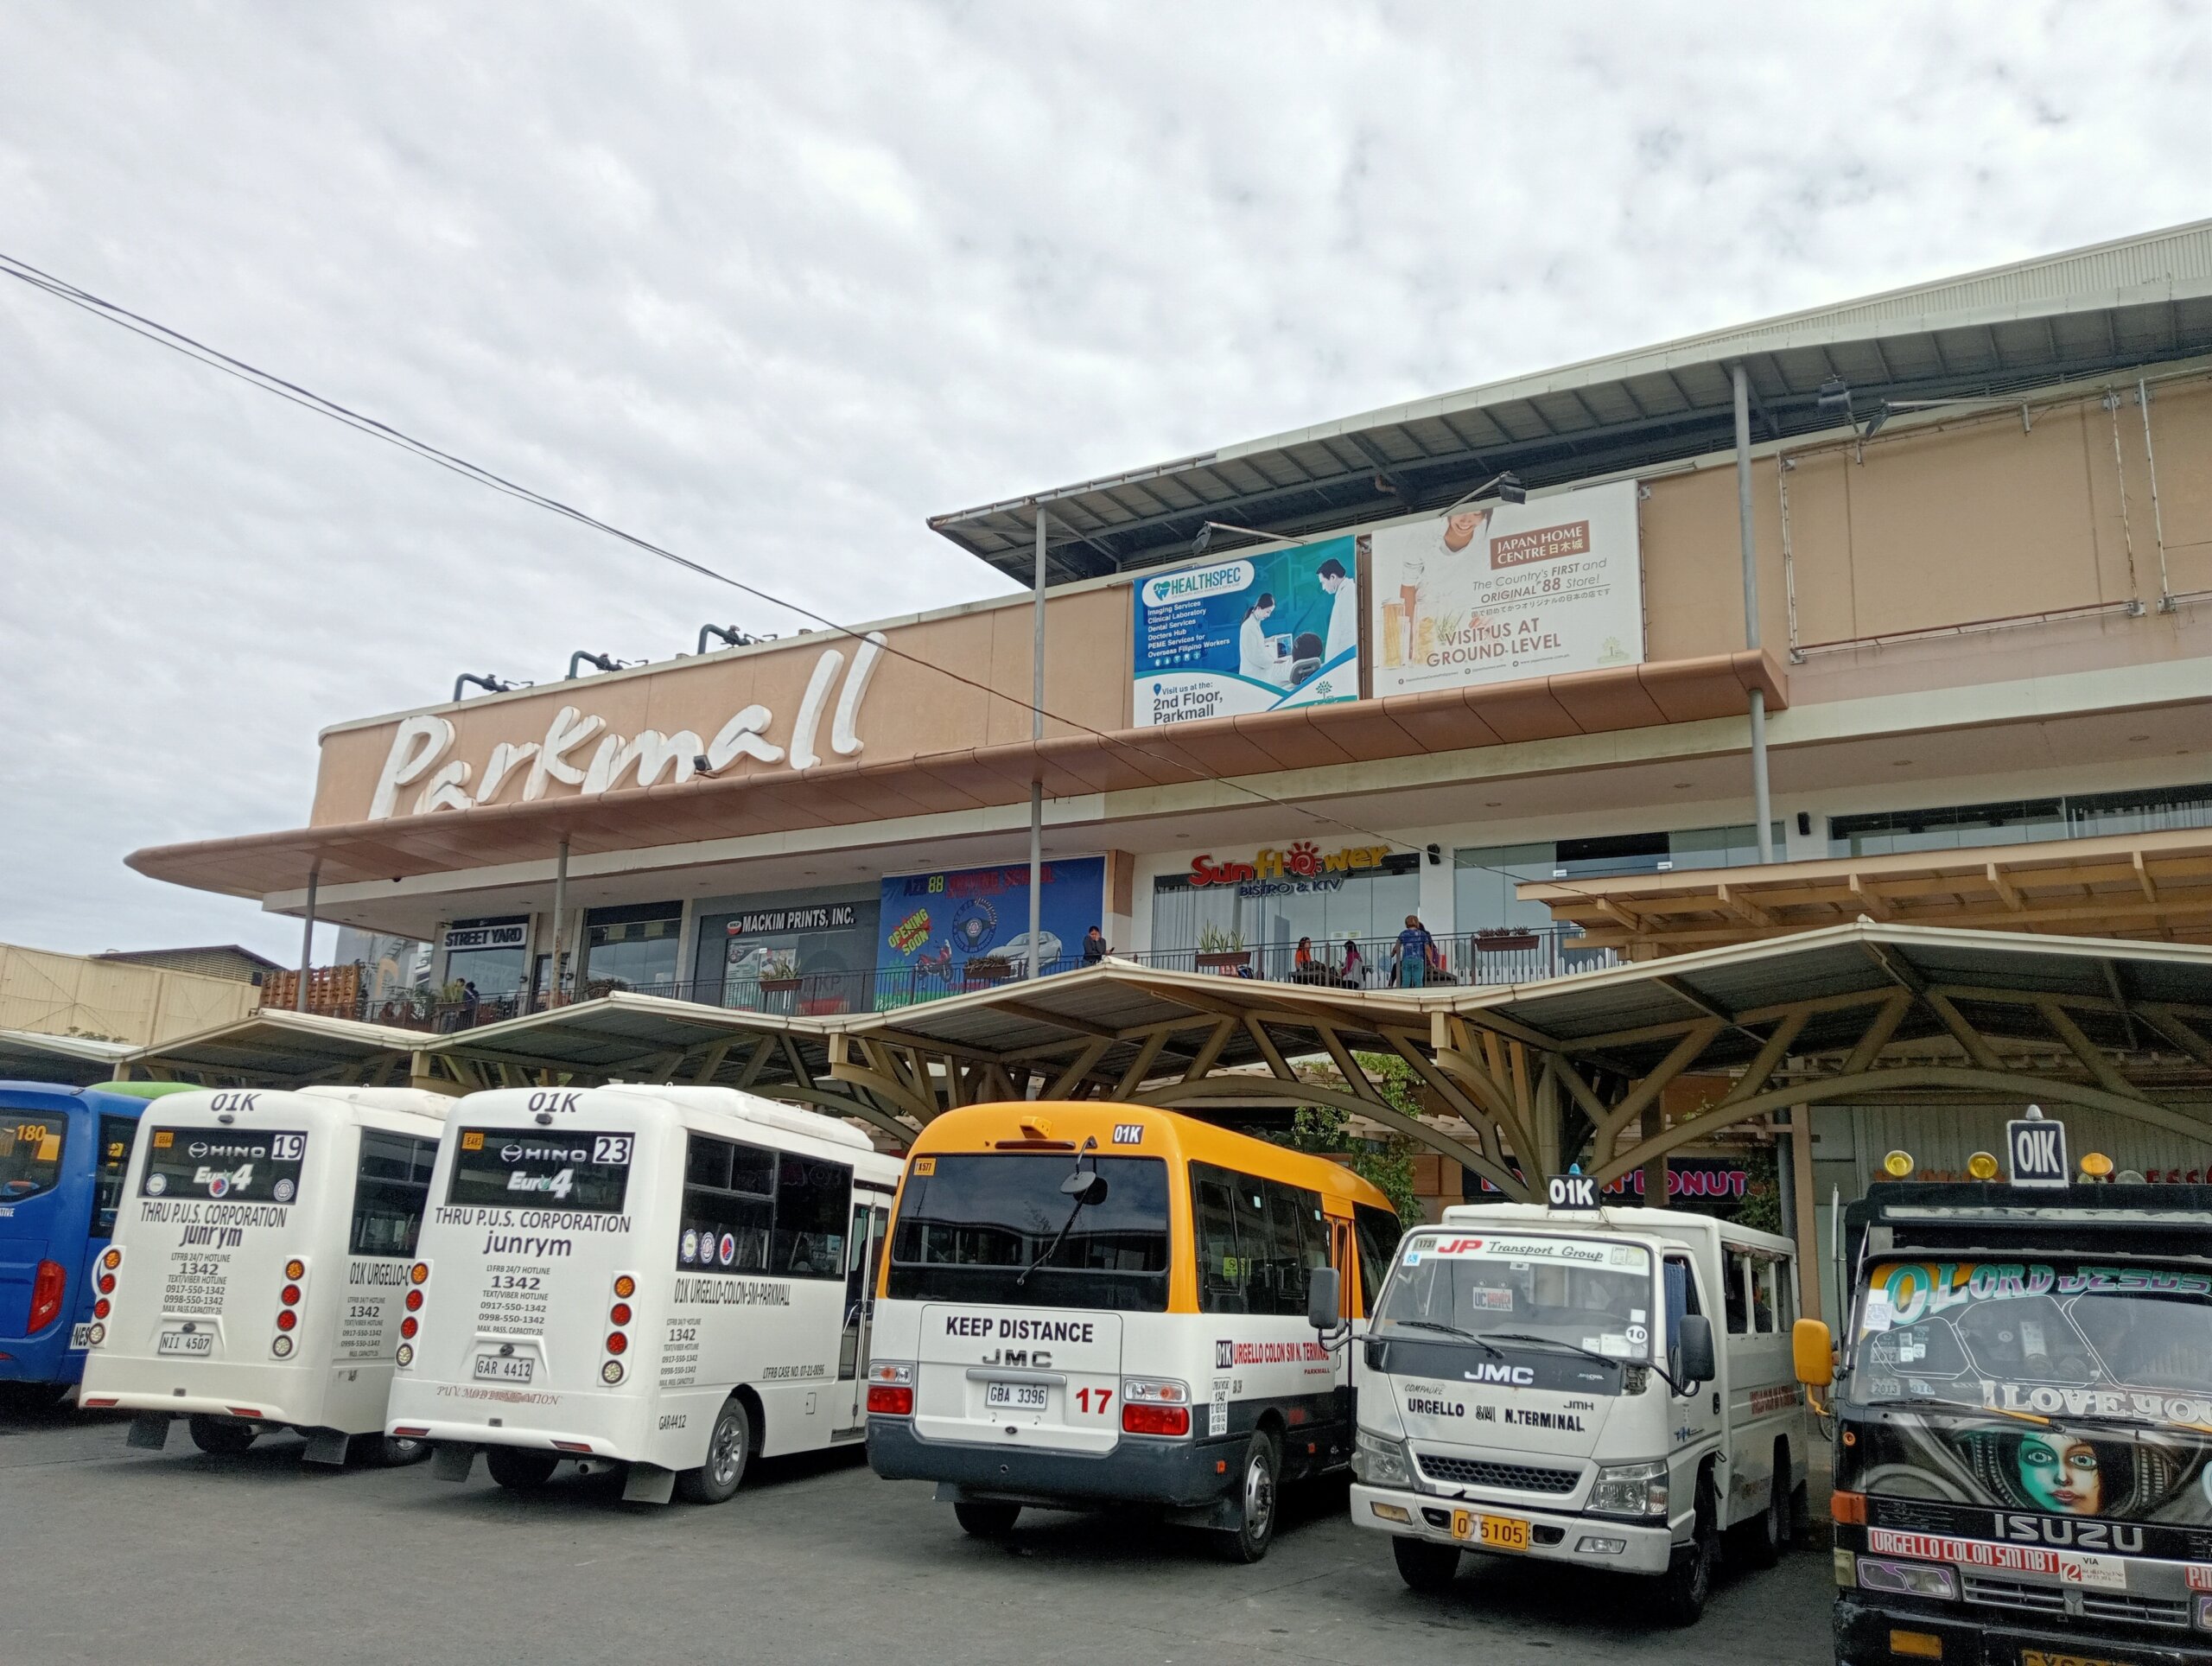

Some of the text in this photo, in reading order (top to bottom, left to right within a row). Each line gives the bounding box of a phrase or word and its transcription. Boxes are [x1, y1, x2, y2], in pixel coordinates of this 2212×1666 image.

[1497, 526, 1583, 554] JAPAN HOME
[1497, 545, 1546, 564] CENTRE
[1171, 567, 1241, 595] HEALTHSPEC
[1472, 557, 1607, 591] The Country's FIRST and
[1481, 574, 1599, 603] ORIGINAL Store!
[1147, 601, 1201, 616] Imaging Services
[1147, 608, 1206, 624] Clinical Laboratory
[1147, 619, 1196, 633] Dental Services
[1445, 617, 1540, 646] VISIT US AT
[1147, 632, 1172, 641] Doctors
[1147, 640, 1166, 650] PEME
[1167, 637, 1194, 646] Services
[1147, 639, 1230, 658] Overseas Filipino Workers
[1427, 633, 1561, 668] GROUND LEVEL
[1162, 686, 1179, 696] Visit
[1199, 681, 1213, 690] the:
[1154, 690, 1224, 711] 2nd Floor,
[1154, 703, 1214, 724] Parkmall
[368, 632, 888, 821] Parkmall
[928, 874, 944, 893] 88
[1240, 878, 1342, 898] BISTRO & KTV
[742, 906, 855, 932] MACKIM PRINTS, INC.
[887, 907, 929, 949] OPENING
[445, 926, 522, 947] STREET YARD
[902, 927, 929, 957] SOON
[210, 1093, 262, 1112] 01K
[528, 1091, 583, 1113] 01K
[17, 1124, 47, 1141] 180
[1114, 1125, 1142, 1143] 01K
[209, 1145, 266, 1158] HINO
[273, 1136, 303, 1160] 19
[524, 1148, 588, 1162] HINO
[595, 1138, 627, 1162] 23
[1549, 1178, 1594, 1206] 01K
[141, 1201, 288, 1228] THRU P.U.S. CORPORATION
[435, 1207, 631, 1233] THRU P.U.S. CORPORATION
[178, 1225, 243, 1250] junrym
[483, 1230, 572, 1258] junrym
[171, 1252, 231, 1262] LTFRB 24/7 HOTLINE
[1437, 1239, 1604, 1262] JP Transport Group
[179, 1262, 219, 1275] 1342
[350, 1262, 367, 1285] 01K
[486, 1264, 550, 1275] LTFRB 24/7 HOTLINE
[166, 1284, 226, 1295] 0917-550-1342
[168, 1275, 227, 1285] TEXT/VIBER HOTLINE
[491, 1275, 540, 1290] 1342
[2058, 1266, 2212, 1294] JESUS
[164, 1294, 224, 1306] 0998-550-1342
[482, 1290, 549, 1301] TEXT/VIBER HOTLINE
[674, 1278, 690, 1304] 01K
[350, 1306, 380, 1318] 1342
[480, 1301, 546, 1313] 0917-550-1342
[479, 1313, 545, 1325] 0998-550-1342
[669, 1328, 696, 1341] 1342
[946, 1316, 1093, 1343] KEEP DISTANCE
[1628, 1329, 1646, 1339] 10
[162, 1336, 210, 1351] NII 4507
[1234, 1343, 1263, 1365] URGELLO
[1264, 1342, 1285, 1363] COLON
[1286, 1342, 1295, 1362] SM
[982, 1348, 1052, 1368] JMC
[1217, 1342, 1232, 1367] 01K
[477, 1360, 531, 1377] GAR 4412
[763, 1366, 778, 1379] LTFRB
[778, 1365, 790, 1378] CASE
[1464, 1363, 1535, 1385] JMC
[990, 1387, 1046, 1404] GBA 3396
[1076, 1387, 1113, 1415] 17
[1563, 1400, 1594, 1411] JMH
[2001, 1384, 2127, 1419] LOVE
[1408, 1398, 1465, 1417] URGELLO
[658, 1415, 687, 1430] GAR4412
[1994, 1513, 2143, 1553] ISUZU
[1874, 1530, 2056, 1574] URGELLO COLON SM NBT
